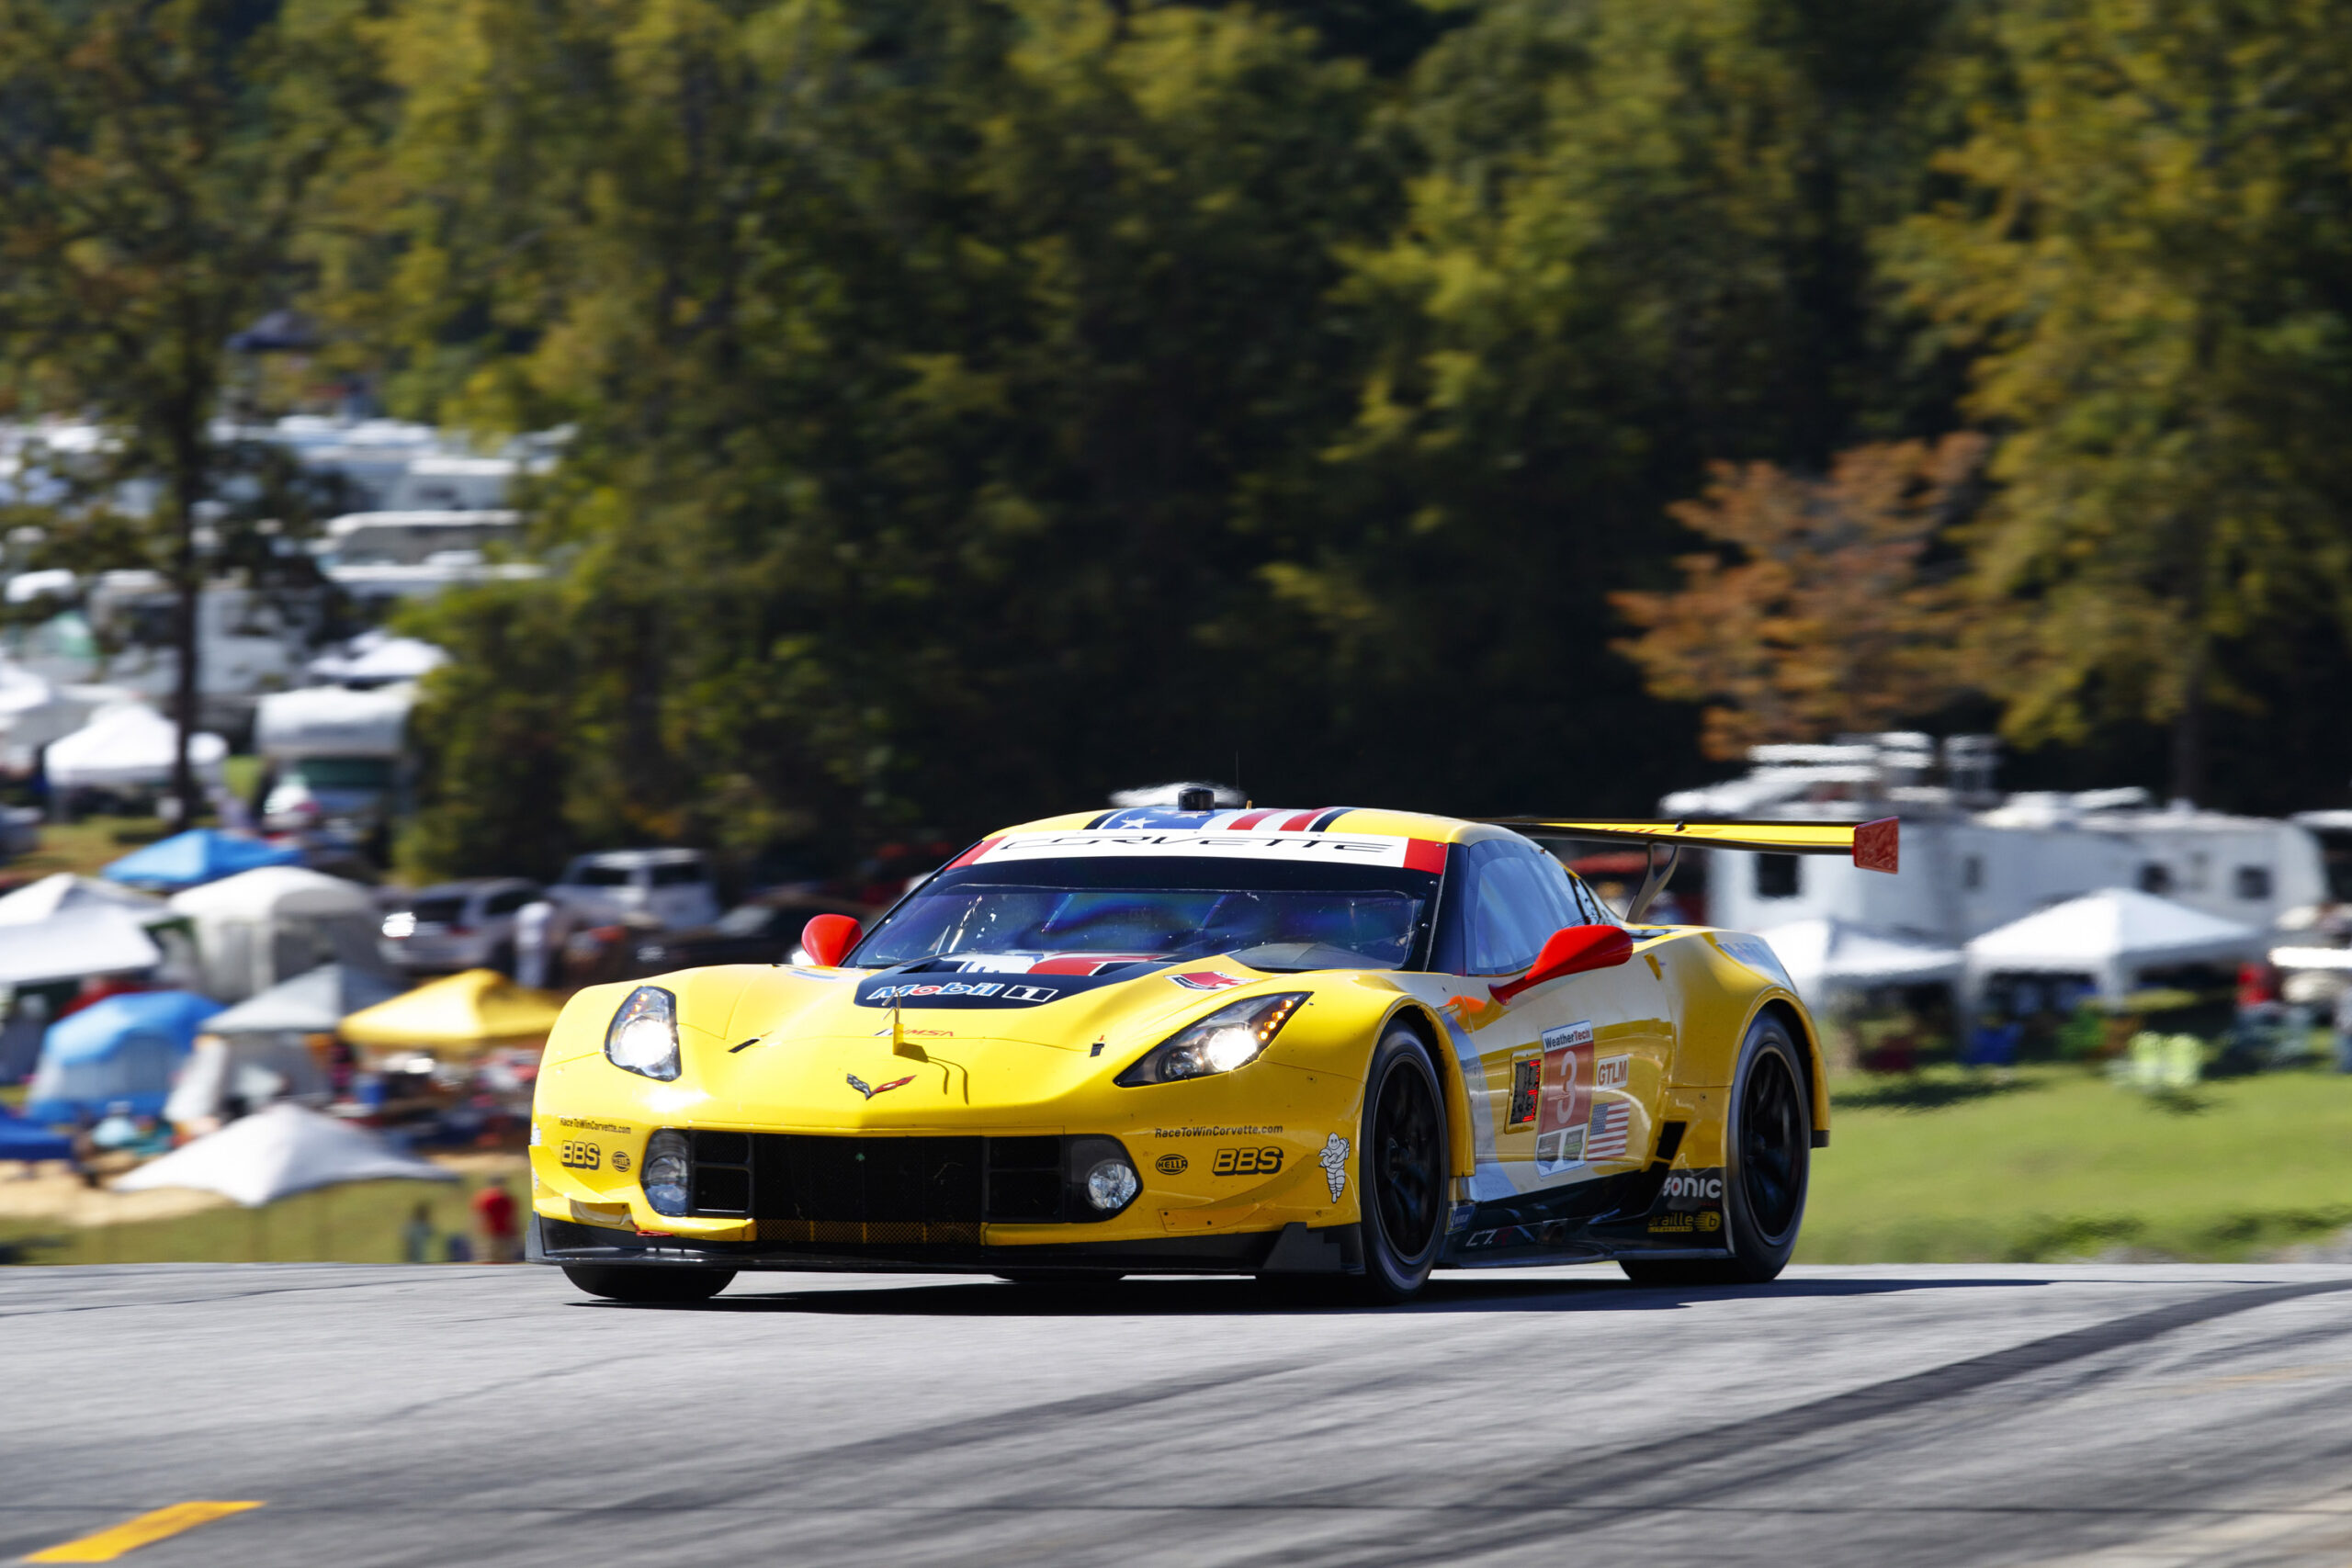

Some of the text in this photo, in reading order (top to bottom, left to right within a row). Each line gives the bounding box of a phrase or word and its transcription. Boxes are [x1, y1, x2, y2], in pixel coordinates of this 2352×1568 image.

[1001, 835, 1395, 853] CORVETTE
[866, 982, 1004, 1000] Mobil
[1544, 1030, 1591, 1049] WeatherTech
[1598, 1060, 1627, 1086] GTLM
[1556, 1050, 1577, 1124] 3
[1155, 1125, 1283, 1138] RaceToWinCorvette.com
[561, 1140, 600, 1170] BBS
[1213, 1146, 1283, 1176] BBS
